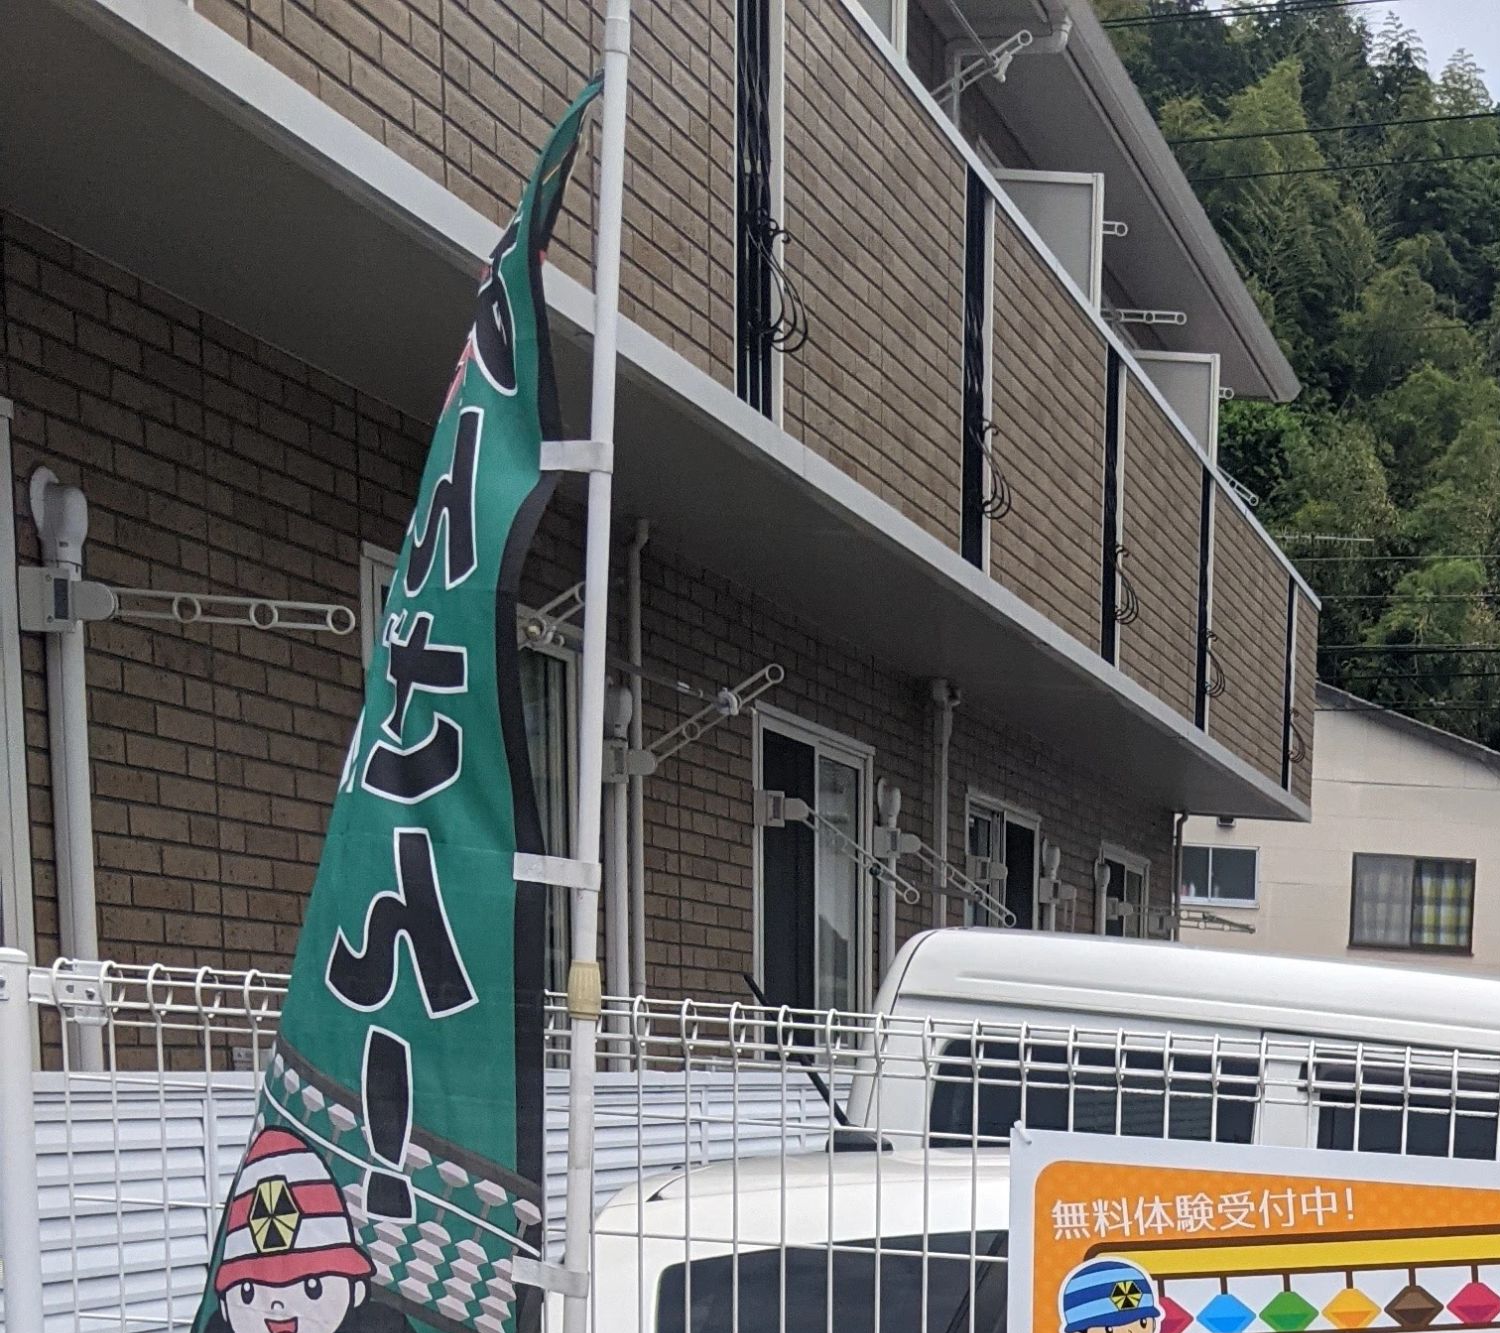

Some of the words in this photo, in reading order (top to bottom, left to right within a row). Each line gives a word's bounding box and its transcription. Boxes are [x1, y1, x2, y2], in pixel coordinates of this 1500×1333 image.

[1050, 1184, 1355, 1241] 無料体験受付中!
